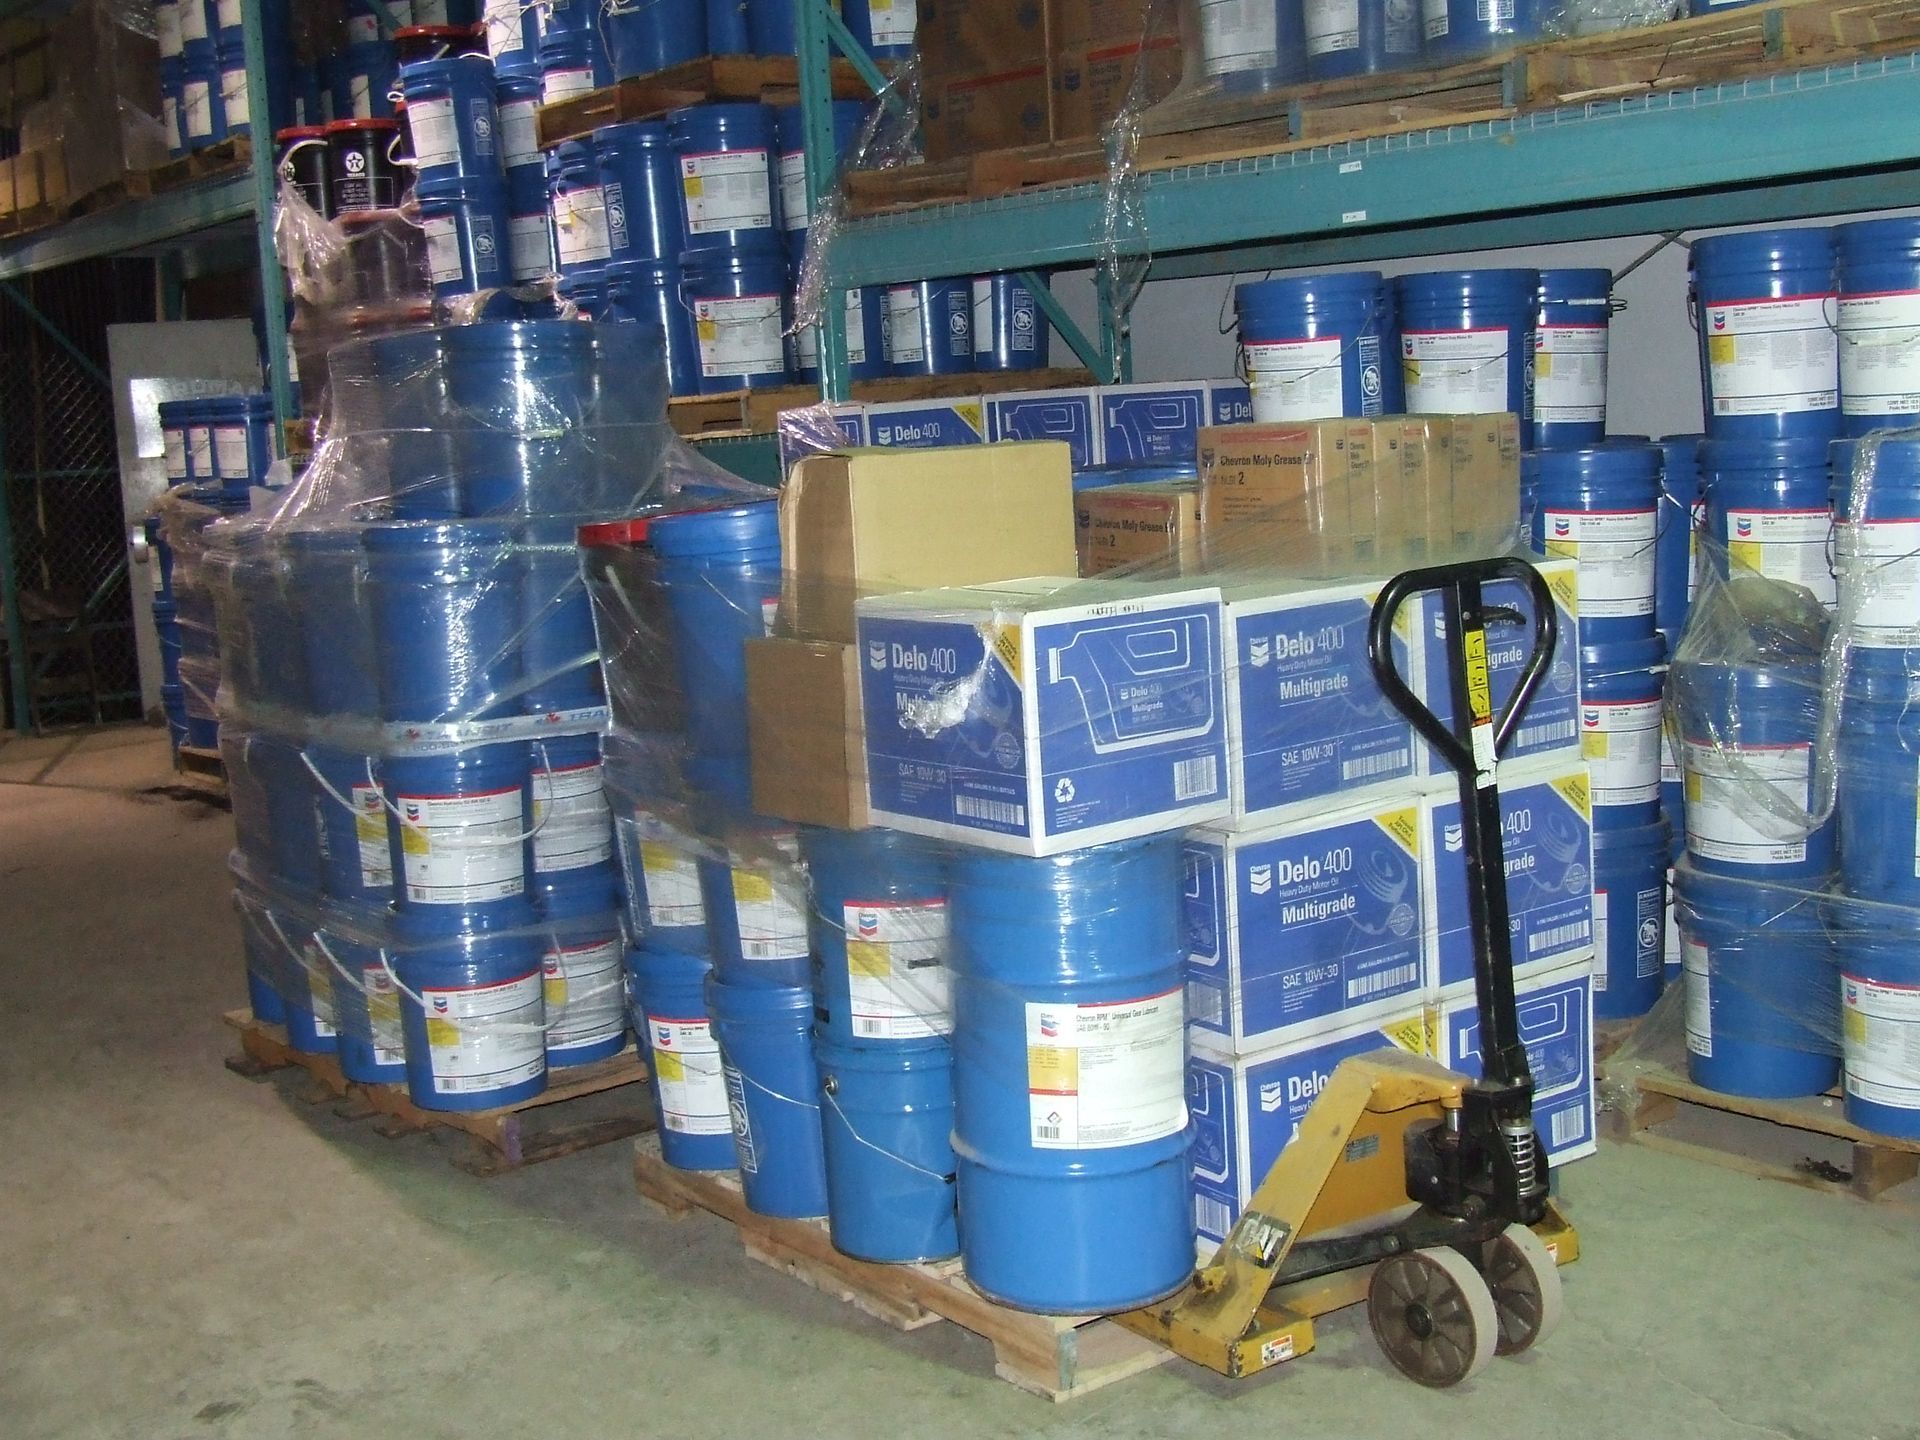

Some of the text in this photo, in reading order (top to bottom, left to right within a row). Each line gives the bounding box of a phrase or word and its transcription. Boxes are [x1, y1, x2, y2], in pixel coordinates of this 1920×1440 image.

[895, 422, 940, 441] Delo 400
[1220, 455, 1251, 466] Chevron
[1253, 454, 1272, 467] Moly
[1274, 454, 1302, 466] Grease
[1238, 471, 1245, 485] 2
[1276, 624, 1344, 660] Delo 400
[892, 643, 956, 674] Delo 400
[1131, 686, 1148, 697] Delo
[1280, 672, 1349, 700] Multigrade
[1132, 701, 1163, 713] Multigrade
[1281, 743, 1334, 767] SAE 10W-30
[899, 763, 914, 776] SAE
[1506, 809, 1531, 835] 400
[1250, 863, 1271, 873] Chevron
[1279, 847, 1352, 886] Delo 400
[1280, 877, 1339, 898] Heavy Duty Motor Oil
[1282, 893, 1356, 925] Multigrade
[1282, 963, 1339, 989] SAE 10W-30
[1076, 1014, 1095, 1022] Chevron
[1112, 1012, 1131, 1020] Universal
[1133, 1009, 1141, 1017] Gear
[1143, 1007, 1158, 1015] Lubricant
[1261, 1081, 1280, 1091] Chevron
[1288, 1070, 1328, 1102] Delo
